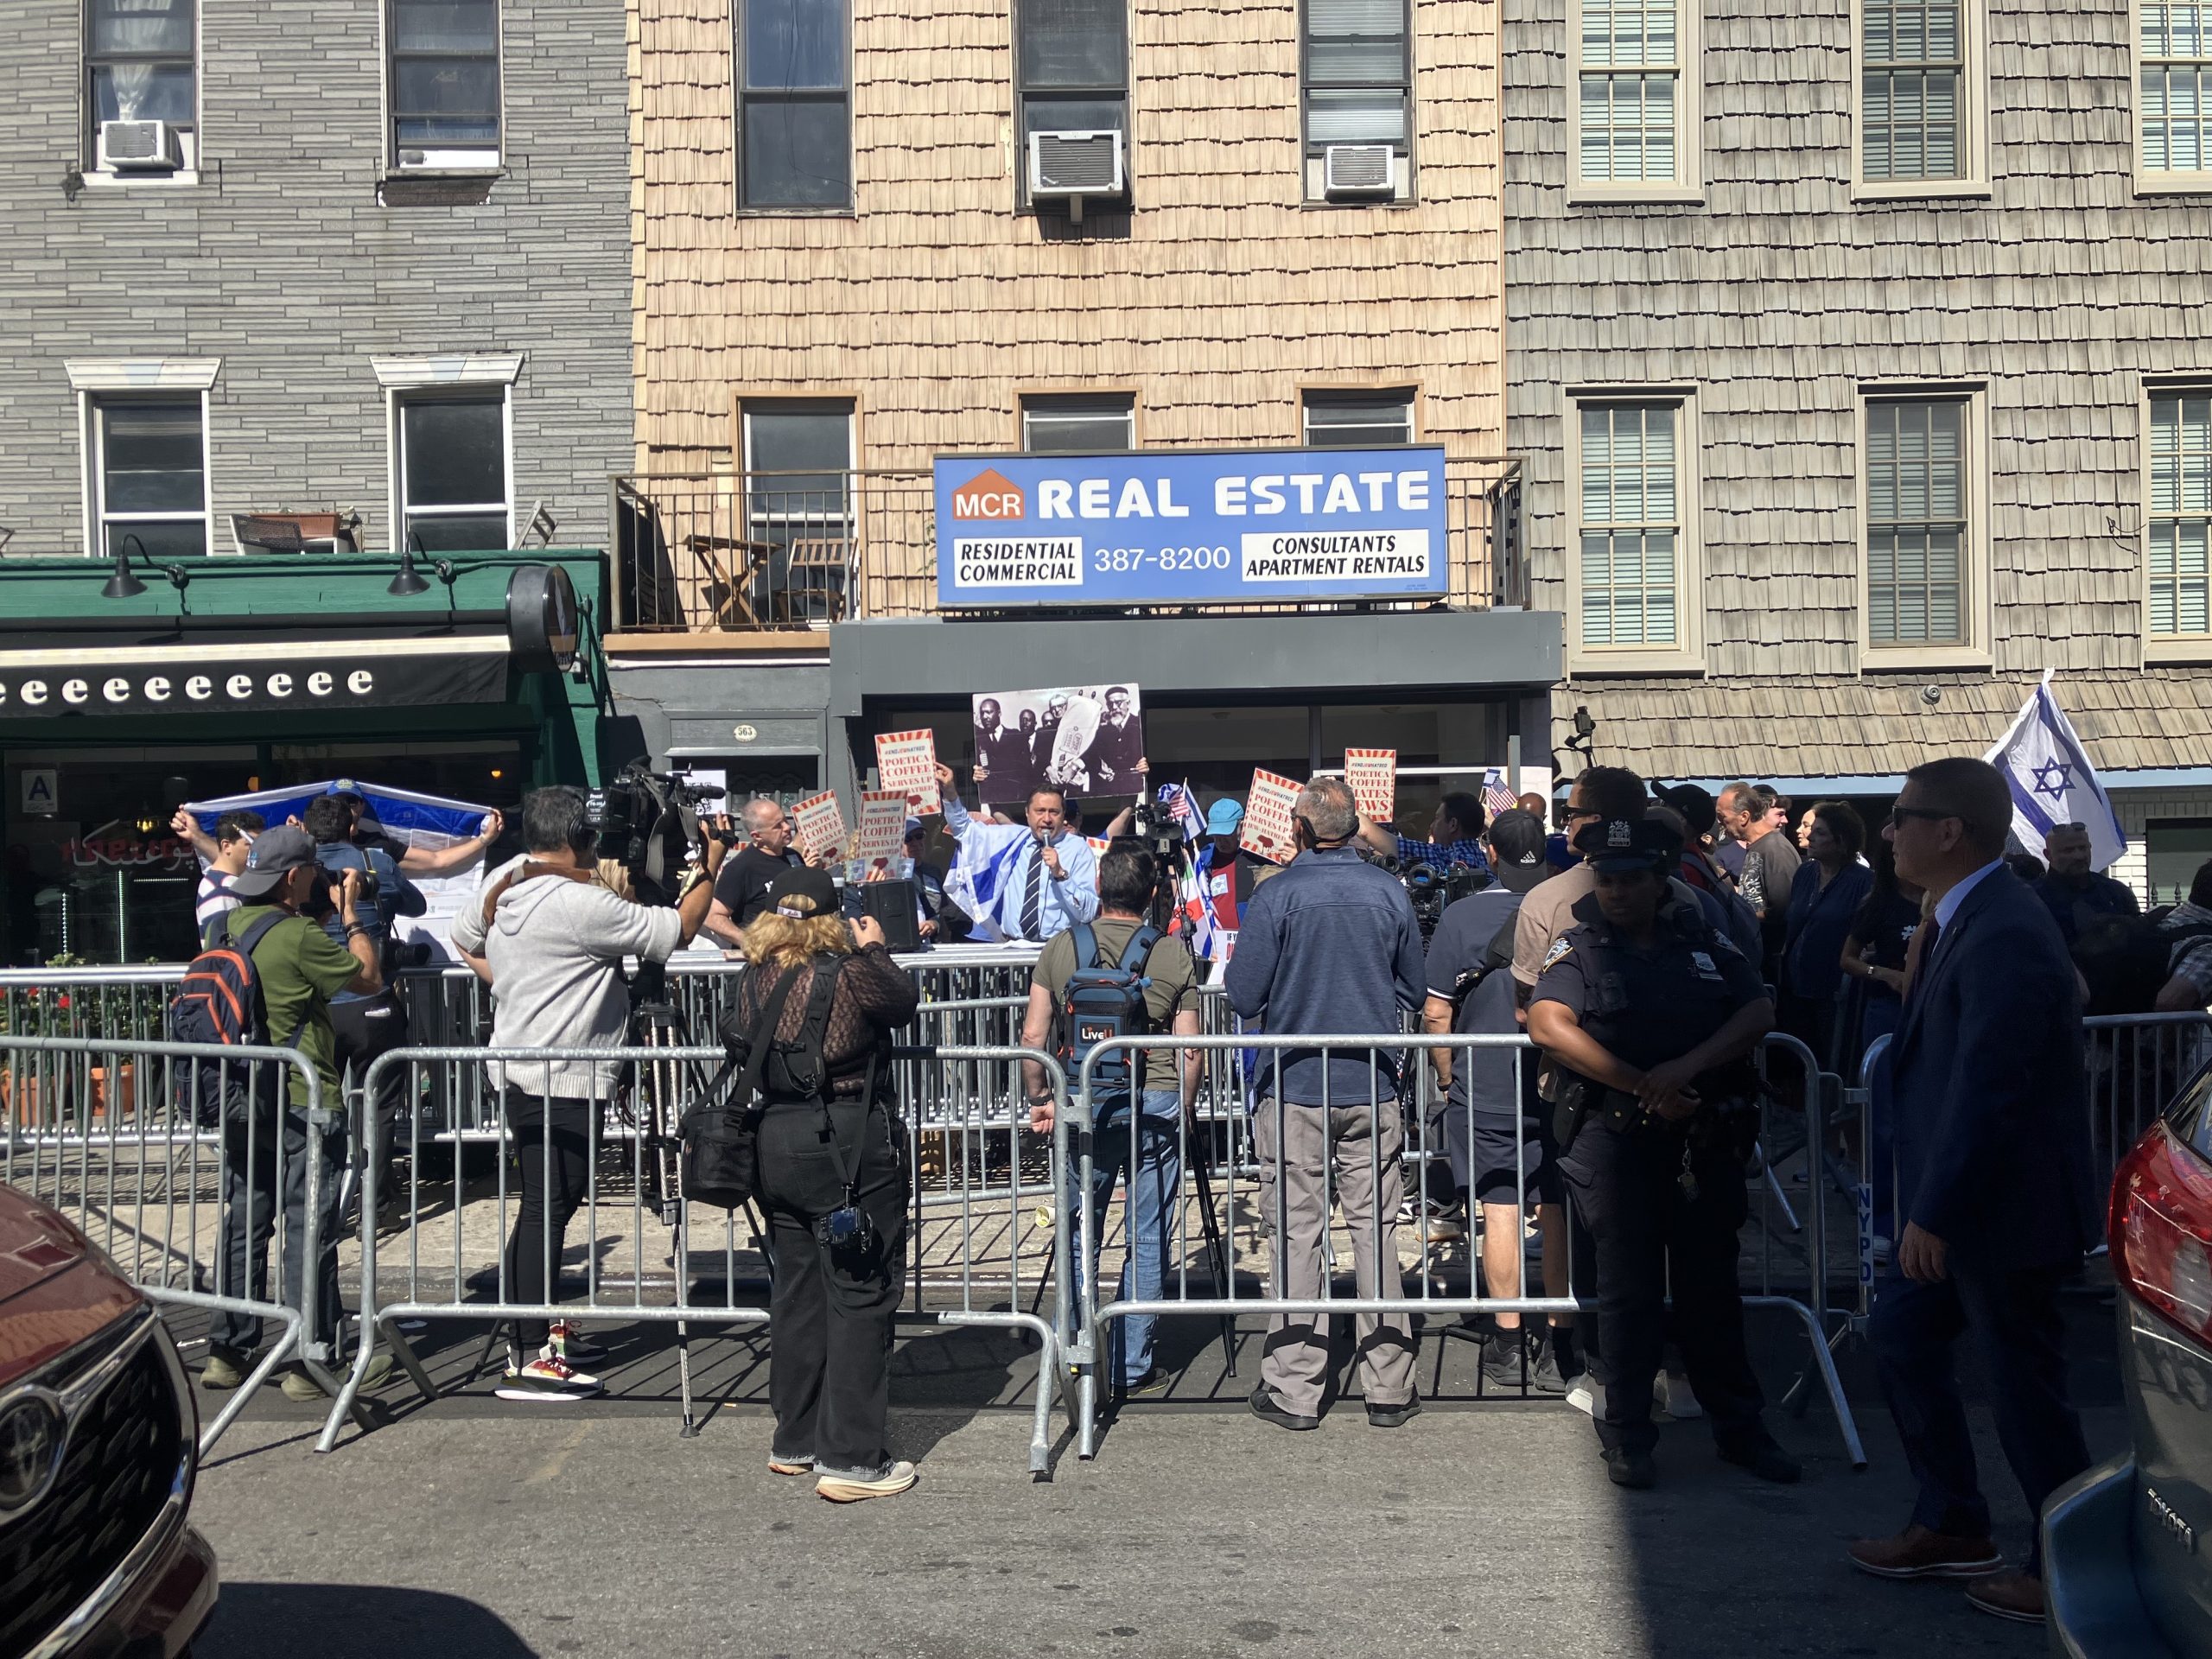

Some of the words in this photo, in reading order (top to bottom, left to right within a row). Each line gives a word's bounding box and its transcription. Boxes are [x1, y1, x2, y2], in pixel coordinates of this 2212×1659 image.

[1038, 478, 1189, 518] REAL
[1214, 470, 1428, 517] ESTATE
[956, 492, 1021, 517] MCR
[961, 543, 1076, 561] RESIDENTIAL
[1272, 535, 1396, 554] CONSULTANTS
[1094, 546, 1230, 572] 387-8200
[1246, 557, 1348, 577] APARTMENT
[1352, 555, 1425, 575] RENTALS
[960, 563, 1077, 582] COMMERCIAL
[738, 727, 753, 735] 563
[885, 754, 929, 766] POETICA
[886, 765, 931, 777] COFFEE
[29, 776, 50, 800] A
[887, 778, 920, 787] SERVES
[1257, 785, 1294, 802] #ENDJEWHATRED
[1252, 803, 1291, 824] COFFEE
[1355, 800, 1389, 810] EWS
[804, 811, 837, 830] POETICA
[865, 816, 900, 825] POETICA
[1249, 814, 1277, 830] SERVES
[1279, 824, 1288, 834] UP
[806, 820, 840, 840] COFFEE
[809, 833, 833, 847] SERVES
[834, 829, 842, 837] UP
[864, 825, 899, 837] COFFEE
[861, 848, 899, 856] JEW-HATRED
[862, 839, 890, 848] SERVES
[1082, 1026, 1112, 1039] LiveU
[1859, 1188, 1872, 1282] NYPD
